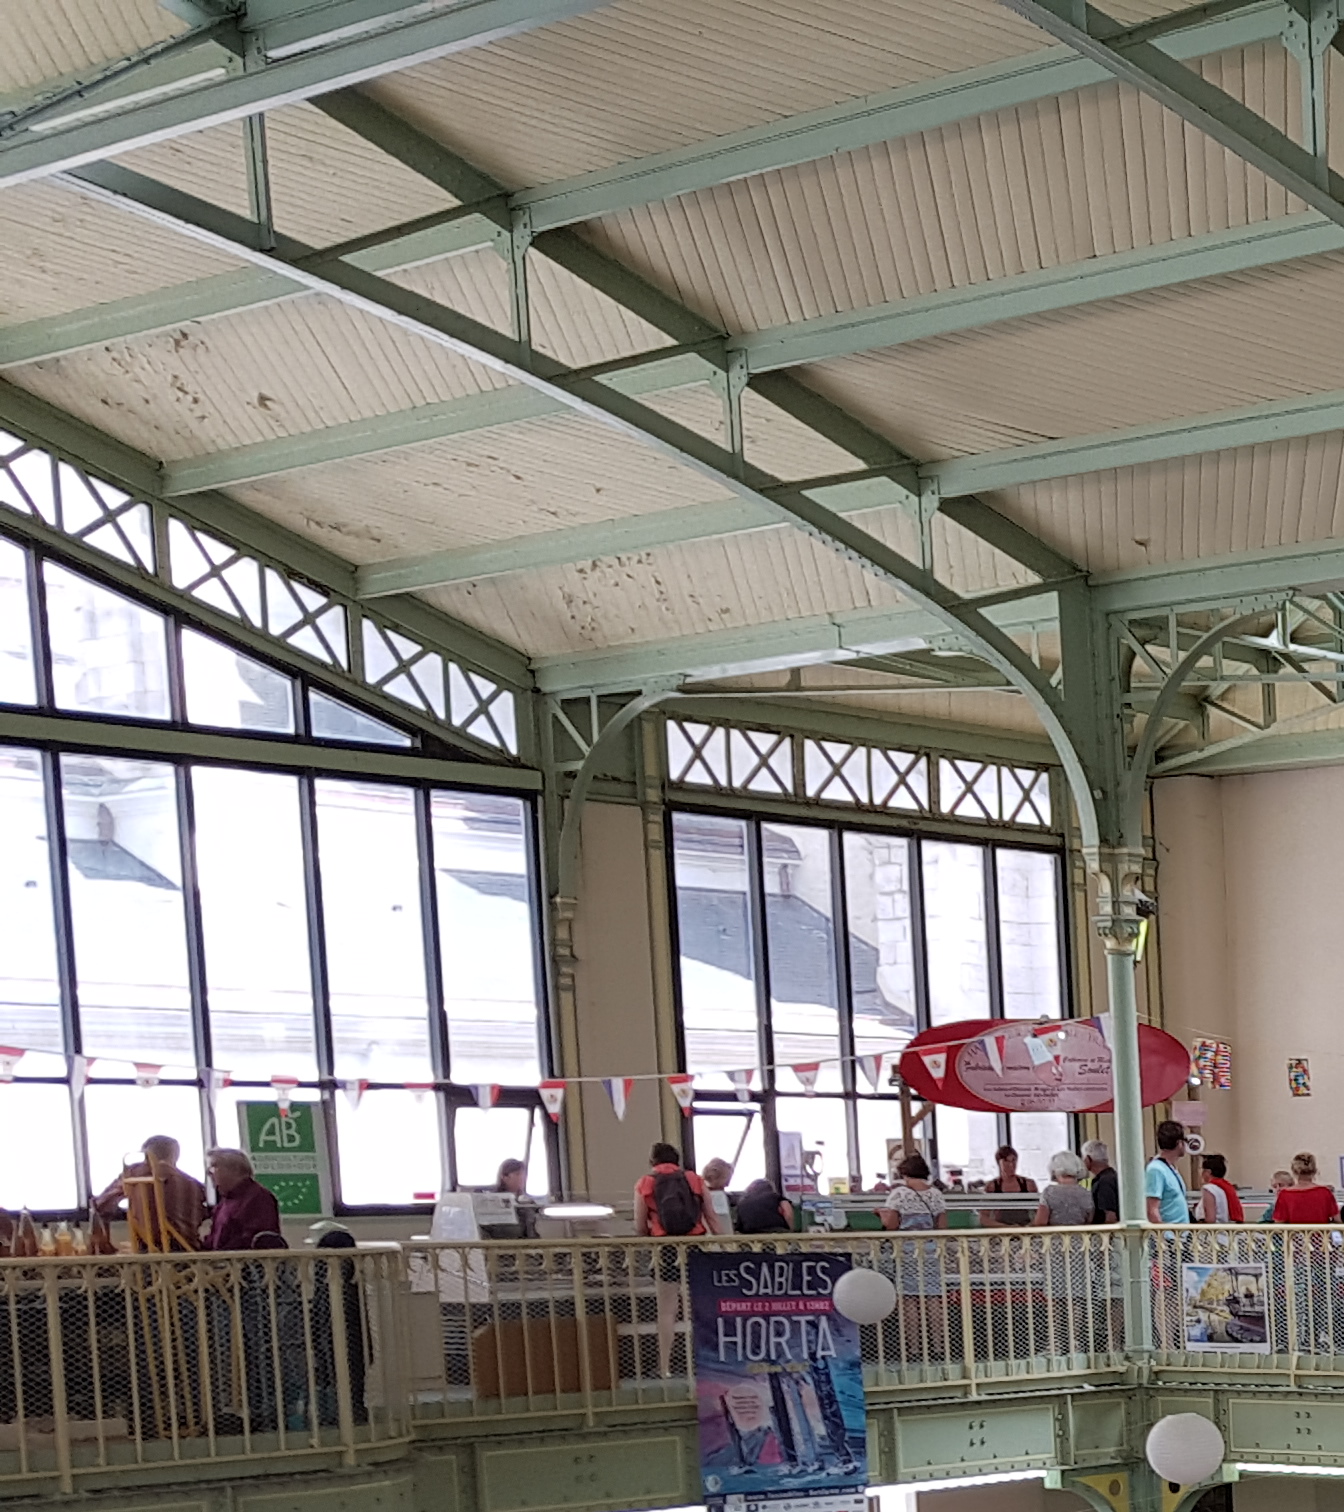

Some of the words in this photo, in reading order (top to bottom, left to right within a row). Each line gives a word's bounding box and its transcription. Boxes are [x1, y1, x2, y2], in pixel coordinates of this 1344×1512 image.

[259, 1117, 300, 1148] AB
[713, 1270, 740, 1286] LES
[739, 1261, 832, 1296] SABLES
[717, 1315, 837, 1361] HORTA
